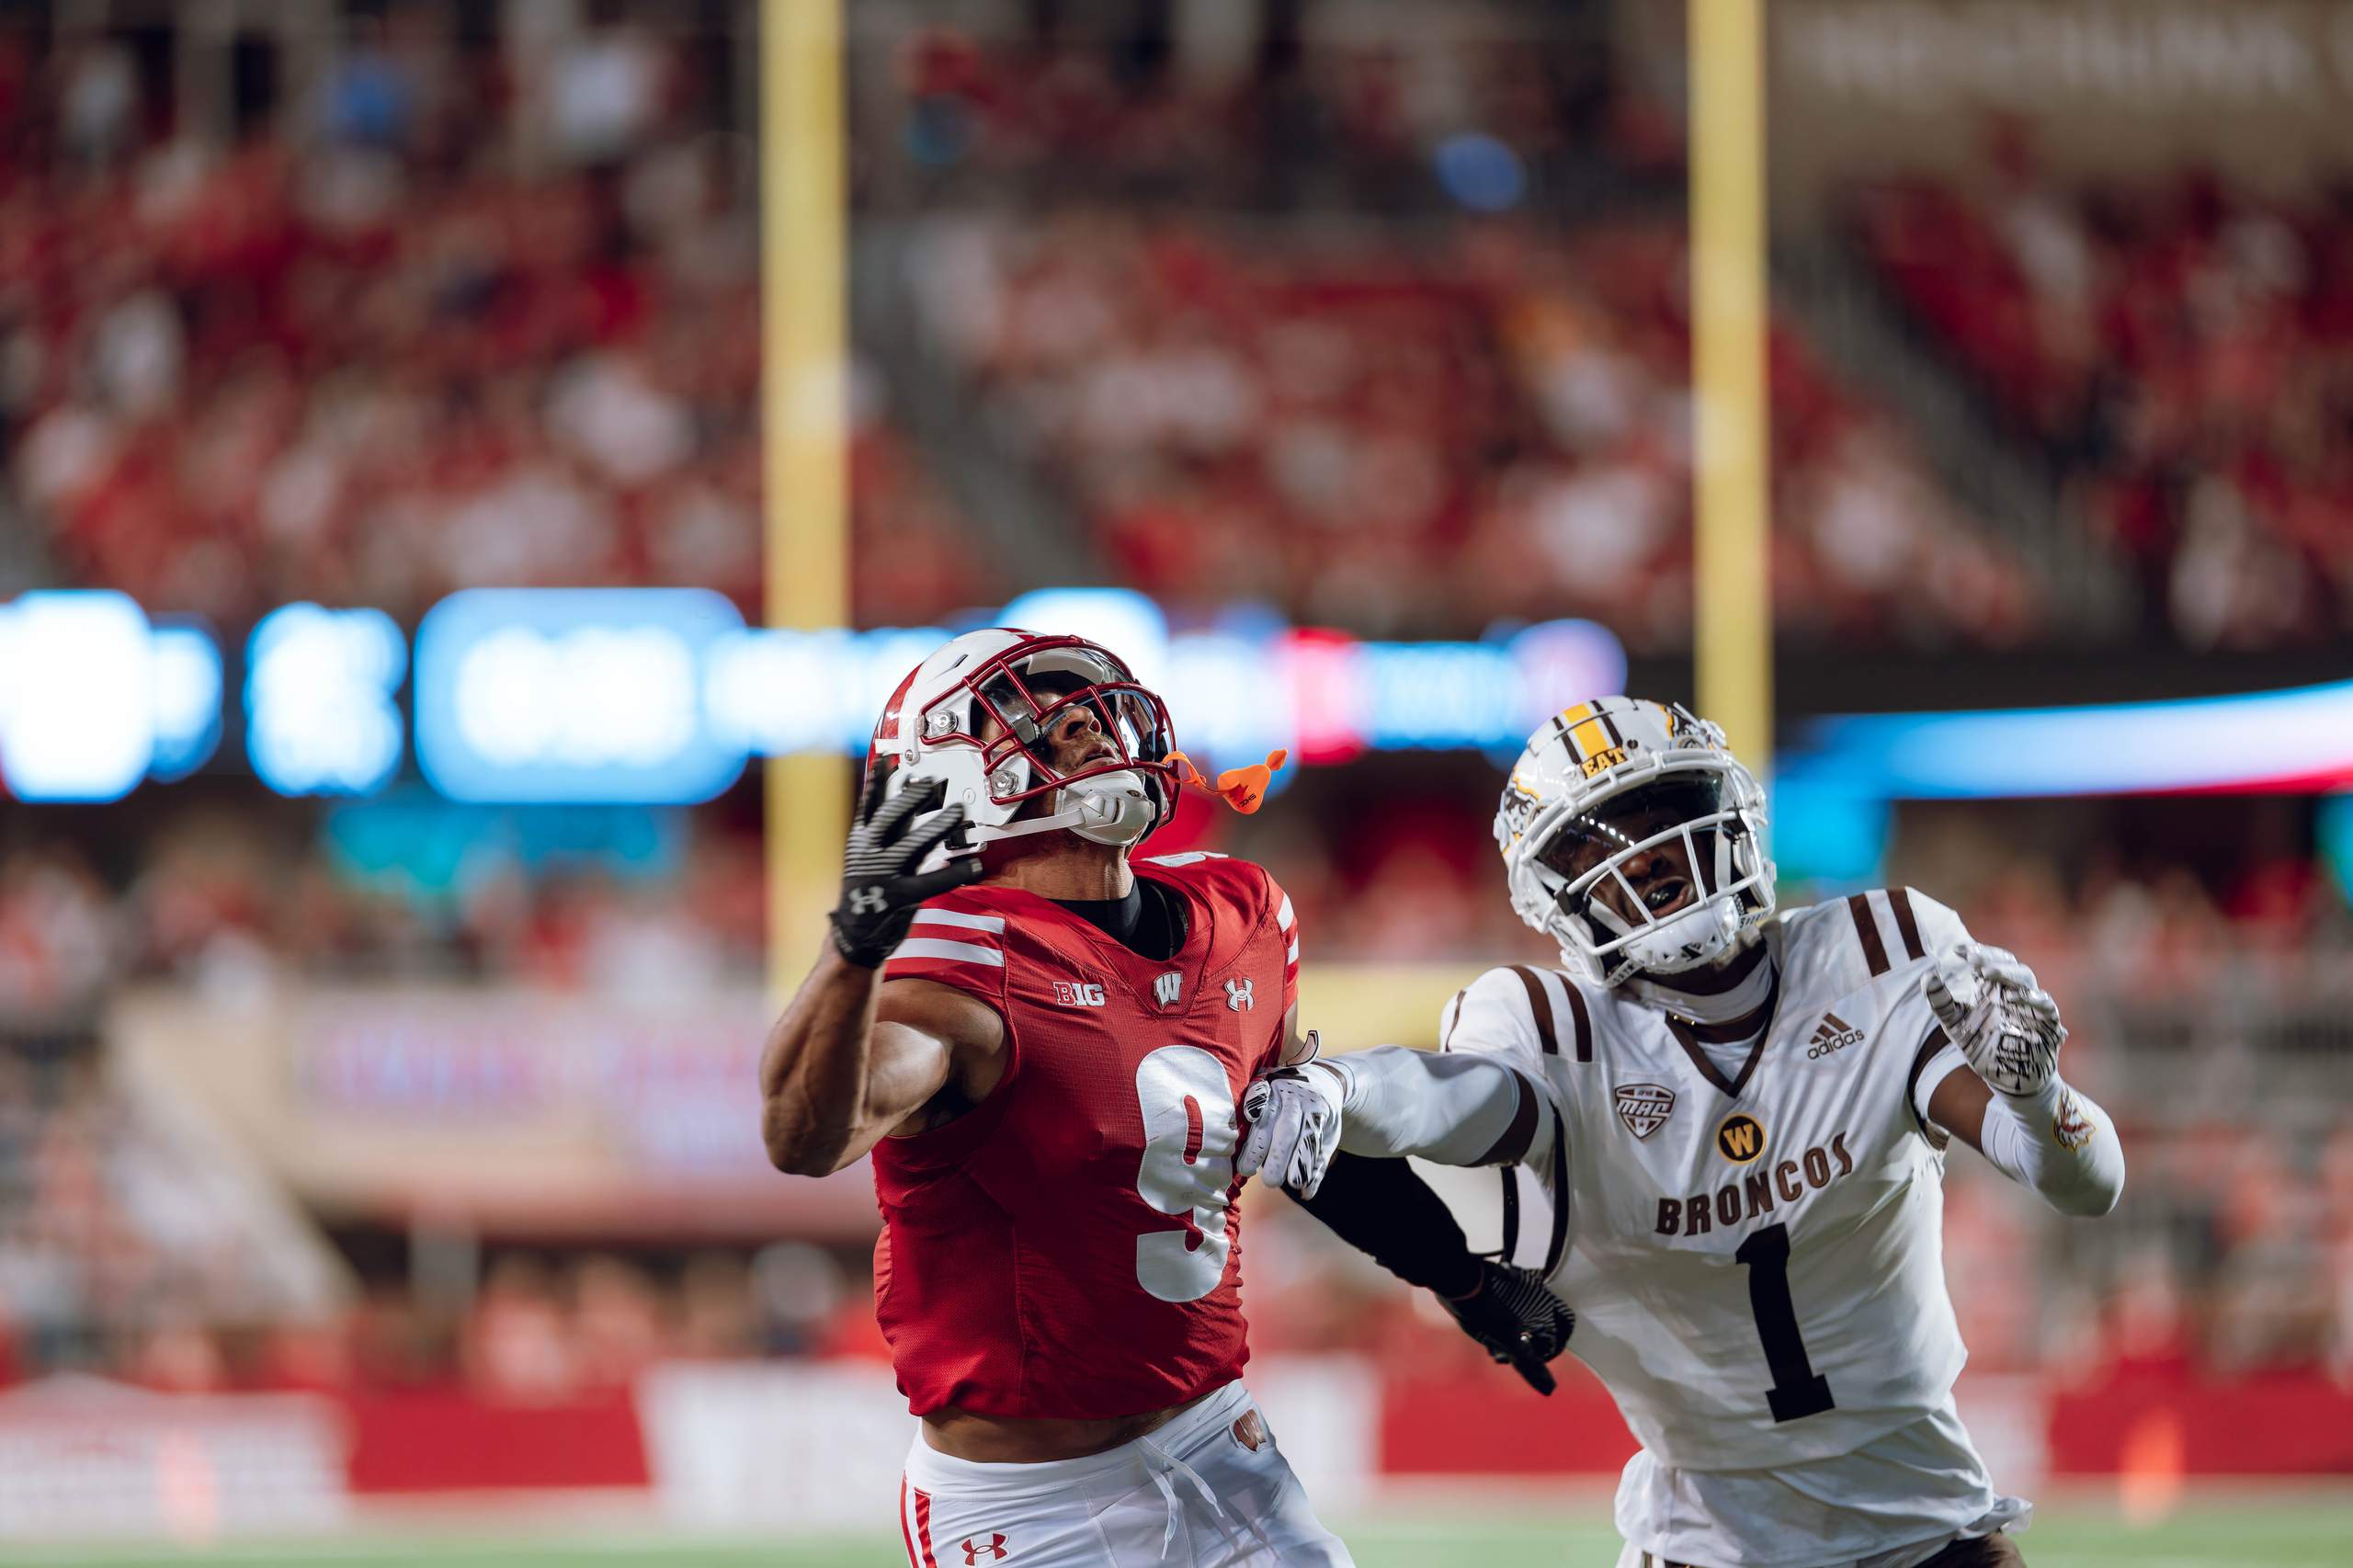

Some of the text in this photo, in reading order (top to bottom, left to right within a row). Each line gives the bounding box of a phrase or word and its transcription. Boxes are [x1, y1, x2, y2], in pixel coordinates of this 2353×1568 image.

[1581, 746, 1627, 779] EAT
[1053, 983, 1106, 1006] BIG
[1154, 971, 1183, 1010] W
[1808, 1029, 1864, 1060] adidas
[1618, 1099, 1671, 1118] MAC
[1723, 1123, 1755, 1157] W
[1136, 1045, 1239, 1302] 9
[1654, 1131, 1853, 1236] BRONCOS
[1735, 1221, 1836, 1423] 1
